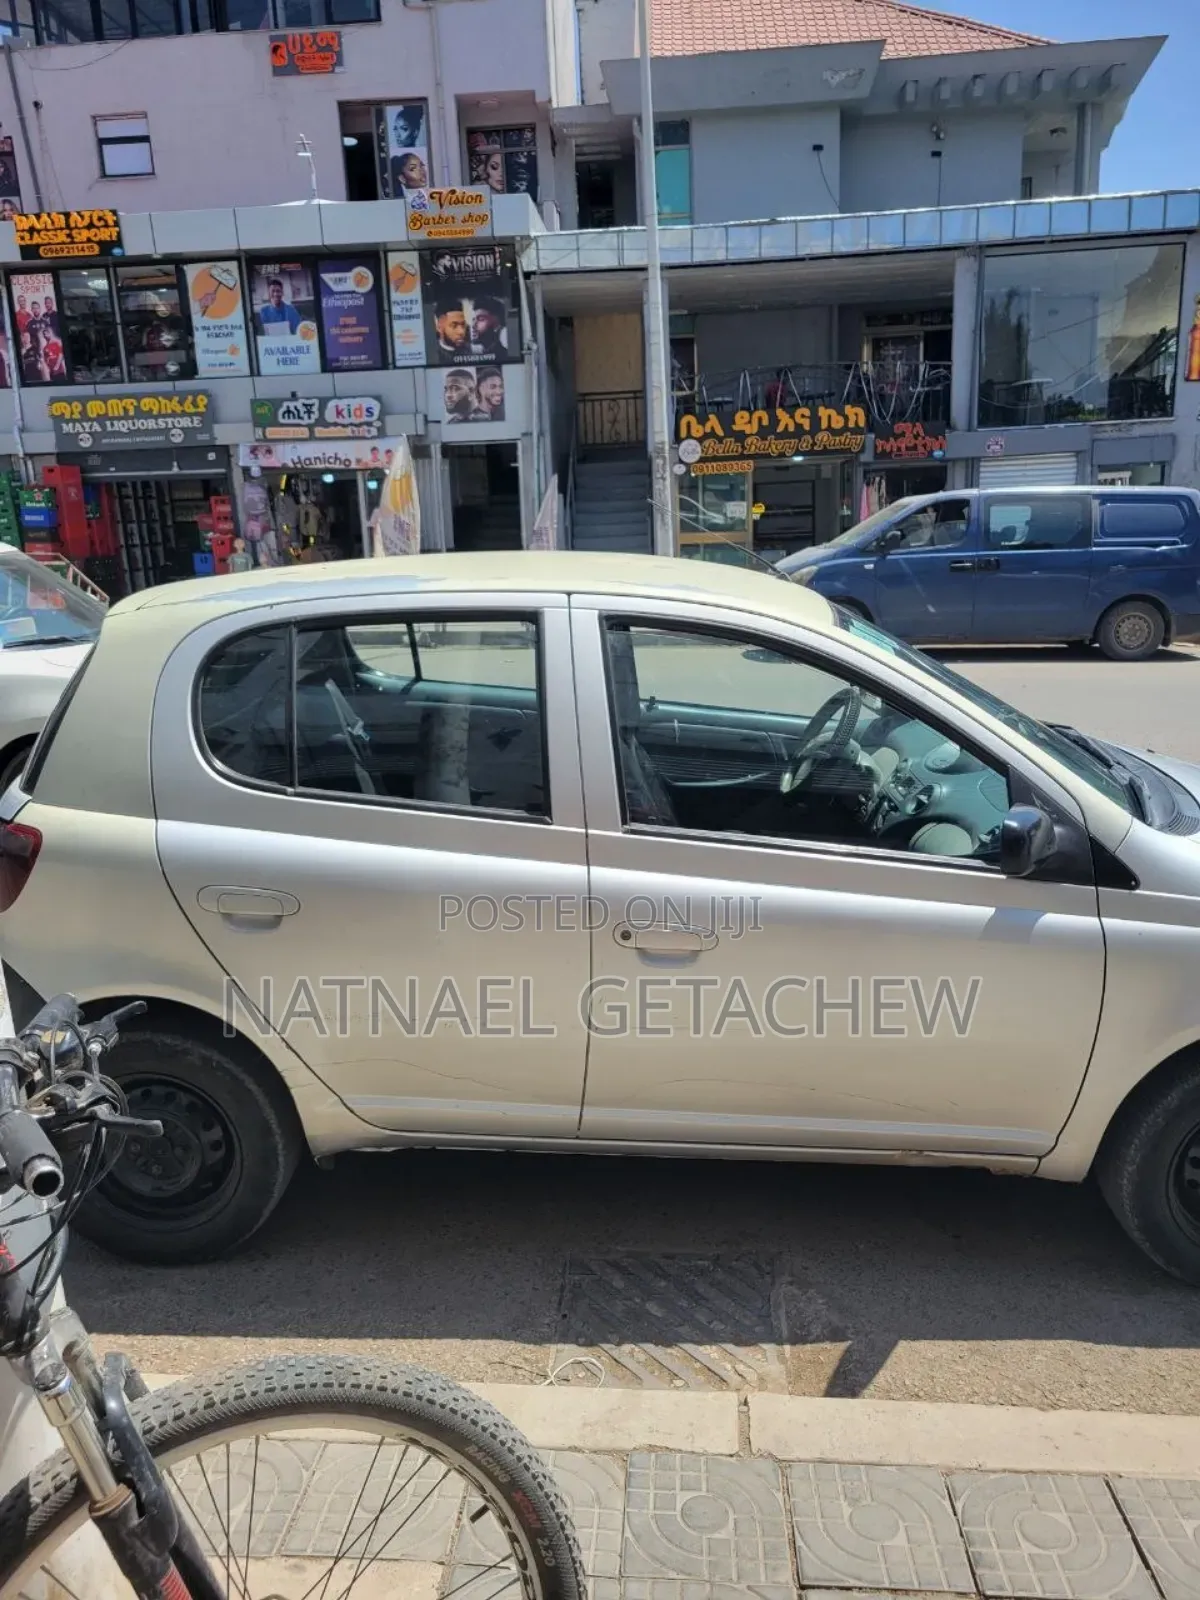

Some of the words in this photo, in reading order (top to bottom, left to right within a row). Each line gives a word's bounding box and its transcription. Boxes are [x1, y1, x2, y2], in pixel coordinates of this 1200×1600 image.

[429, 188, 484, 209] Vision
[409, 212, 456, 231] Barber
[461, 212, 490, 226] shop
[16, 230, 72, 245] CLASSIC
[71, 227, 119, 243] SPORT
[451, 254, 495, 272] VISION
[11, 274, 53, 286] CLASSIC
[20, 284, 46, 294] SPORT
[264, 345, 311, 357] AVAILABLE
[276, 357, 300, 366] HERE
[335, 404, 374, 419] kids
[61, 421, 102, 434] MAYA
[105, 416, 203, 433] LIQUORSTORE
[701, 439, 742, 456] Bella
[744, 436, 799, 455] Bakery
[800, 434, 812, 450] &
[815, 431, 863, 451] Pastry
